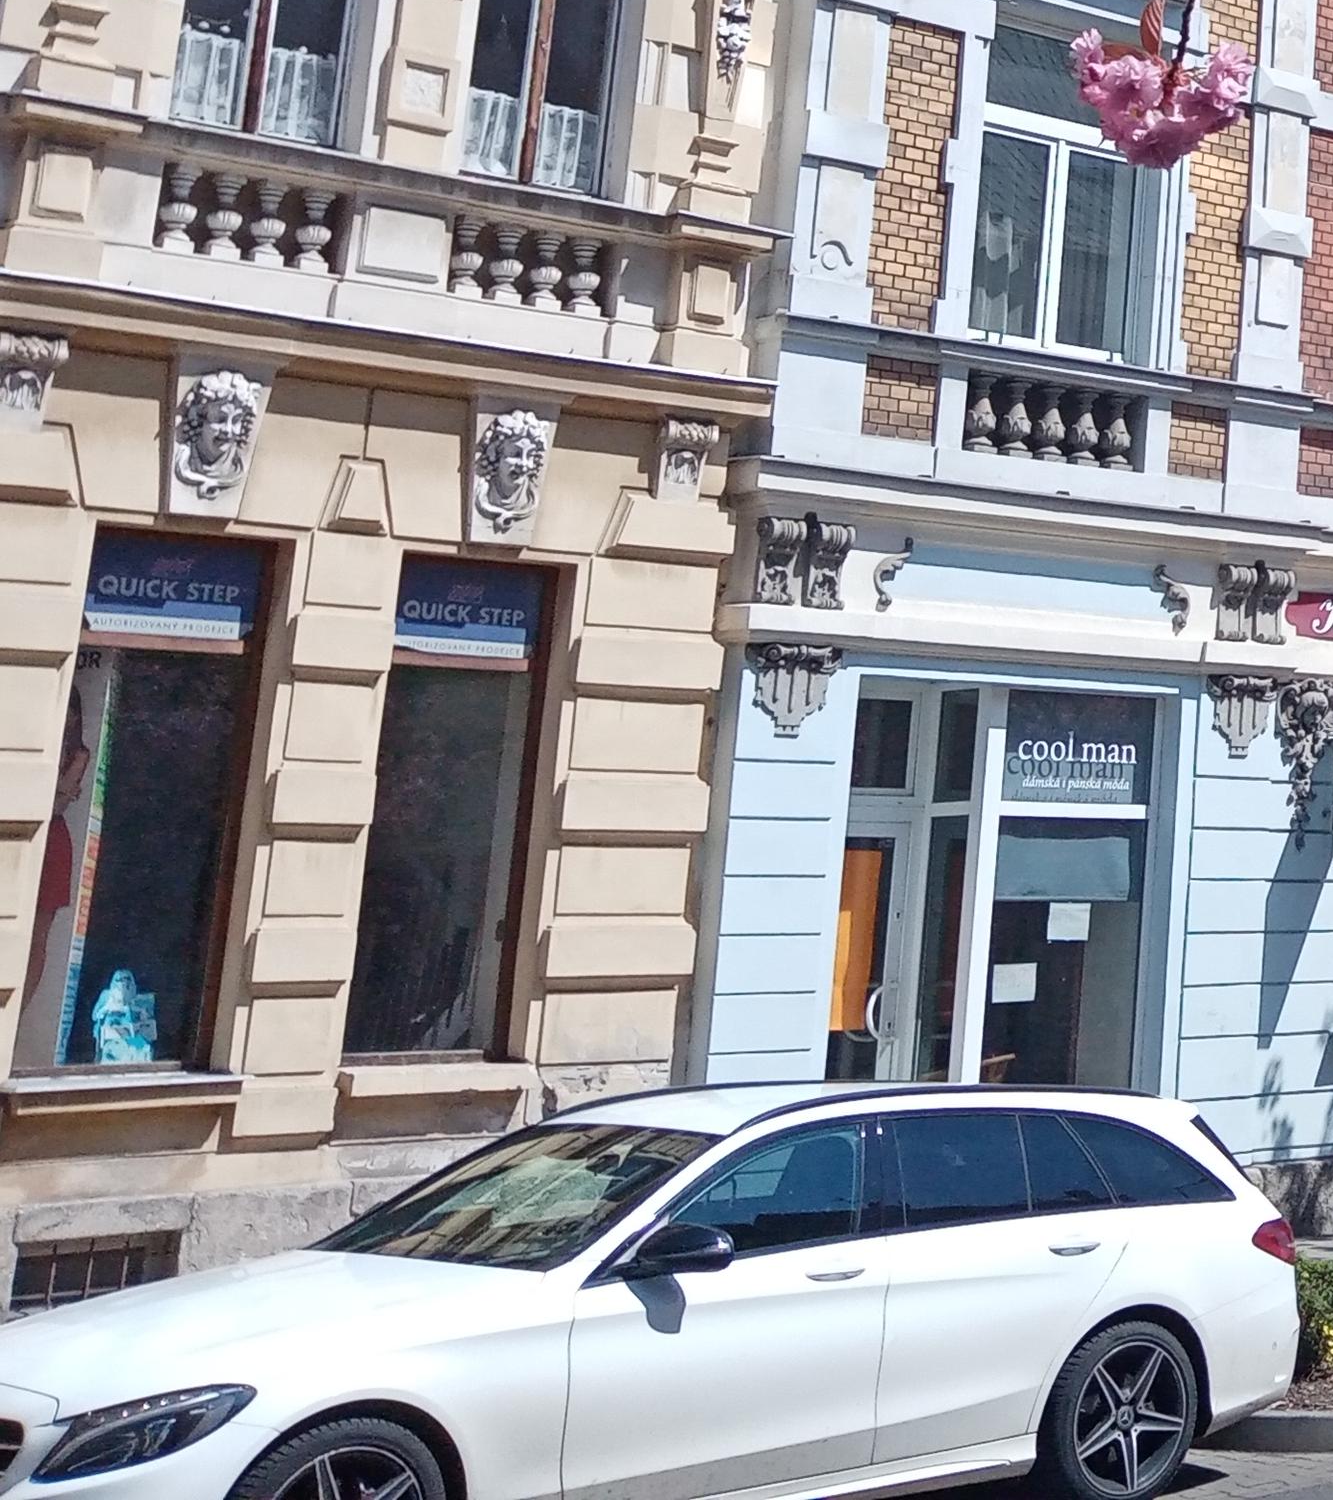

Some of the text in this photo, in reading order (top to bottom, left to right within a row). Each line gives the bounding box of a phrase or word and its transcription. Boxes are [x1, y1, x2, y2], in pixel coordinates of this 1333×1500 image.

[98, 575, 241, 604] QUICK STEP
[402, 600, 527, 626] QUICK STEP
[1018, 731, 1138, 765] cool man
[1022, 773, 1060, 789] dámská
